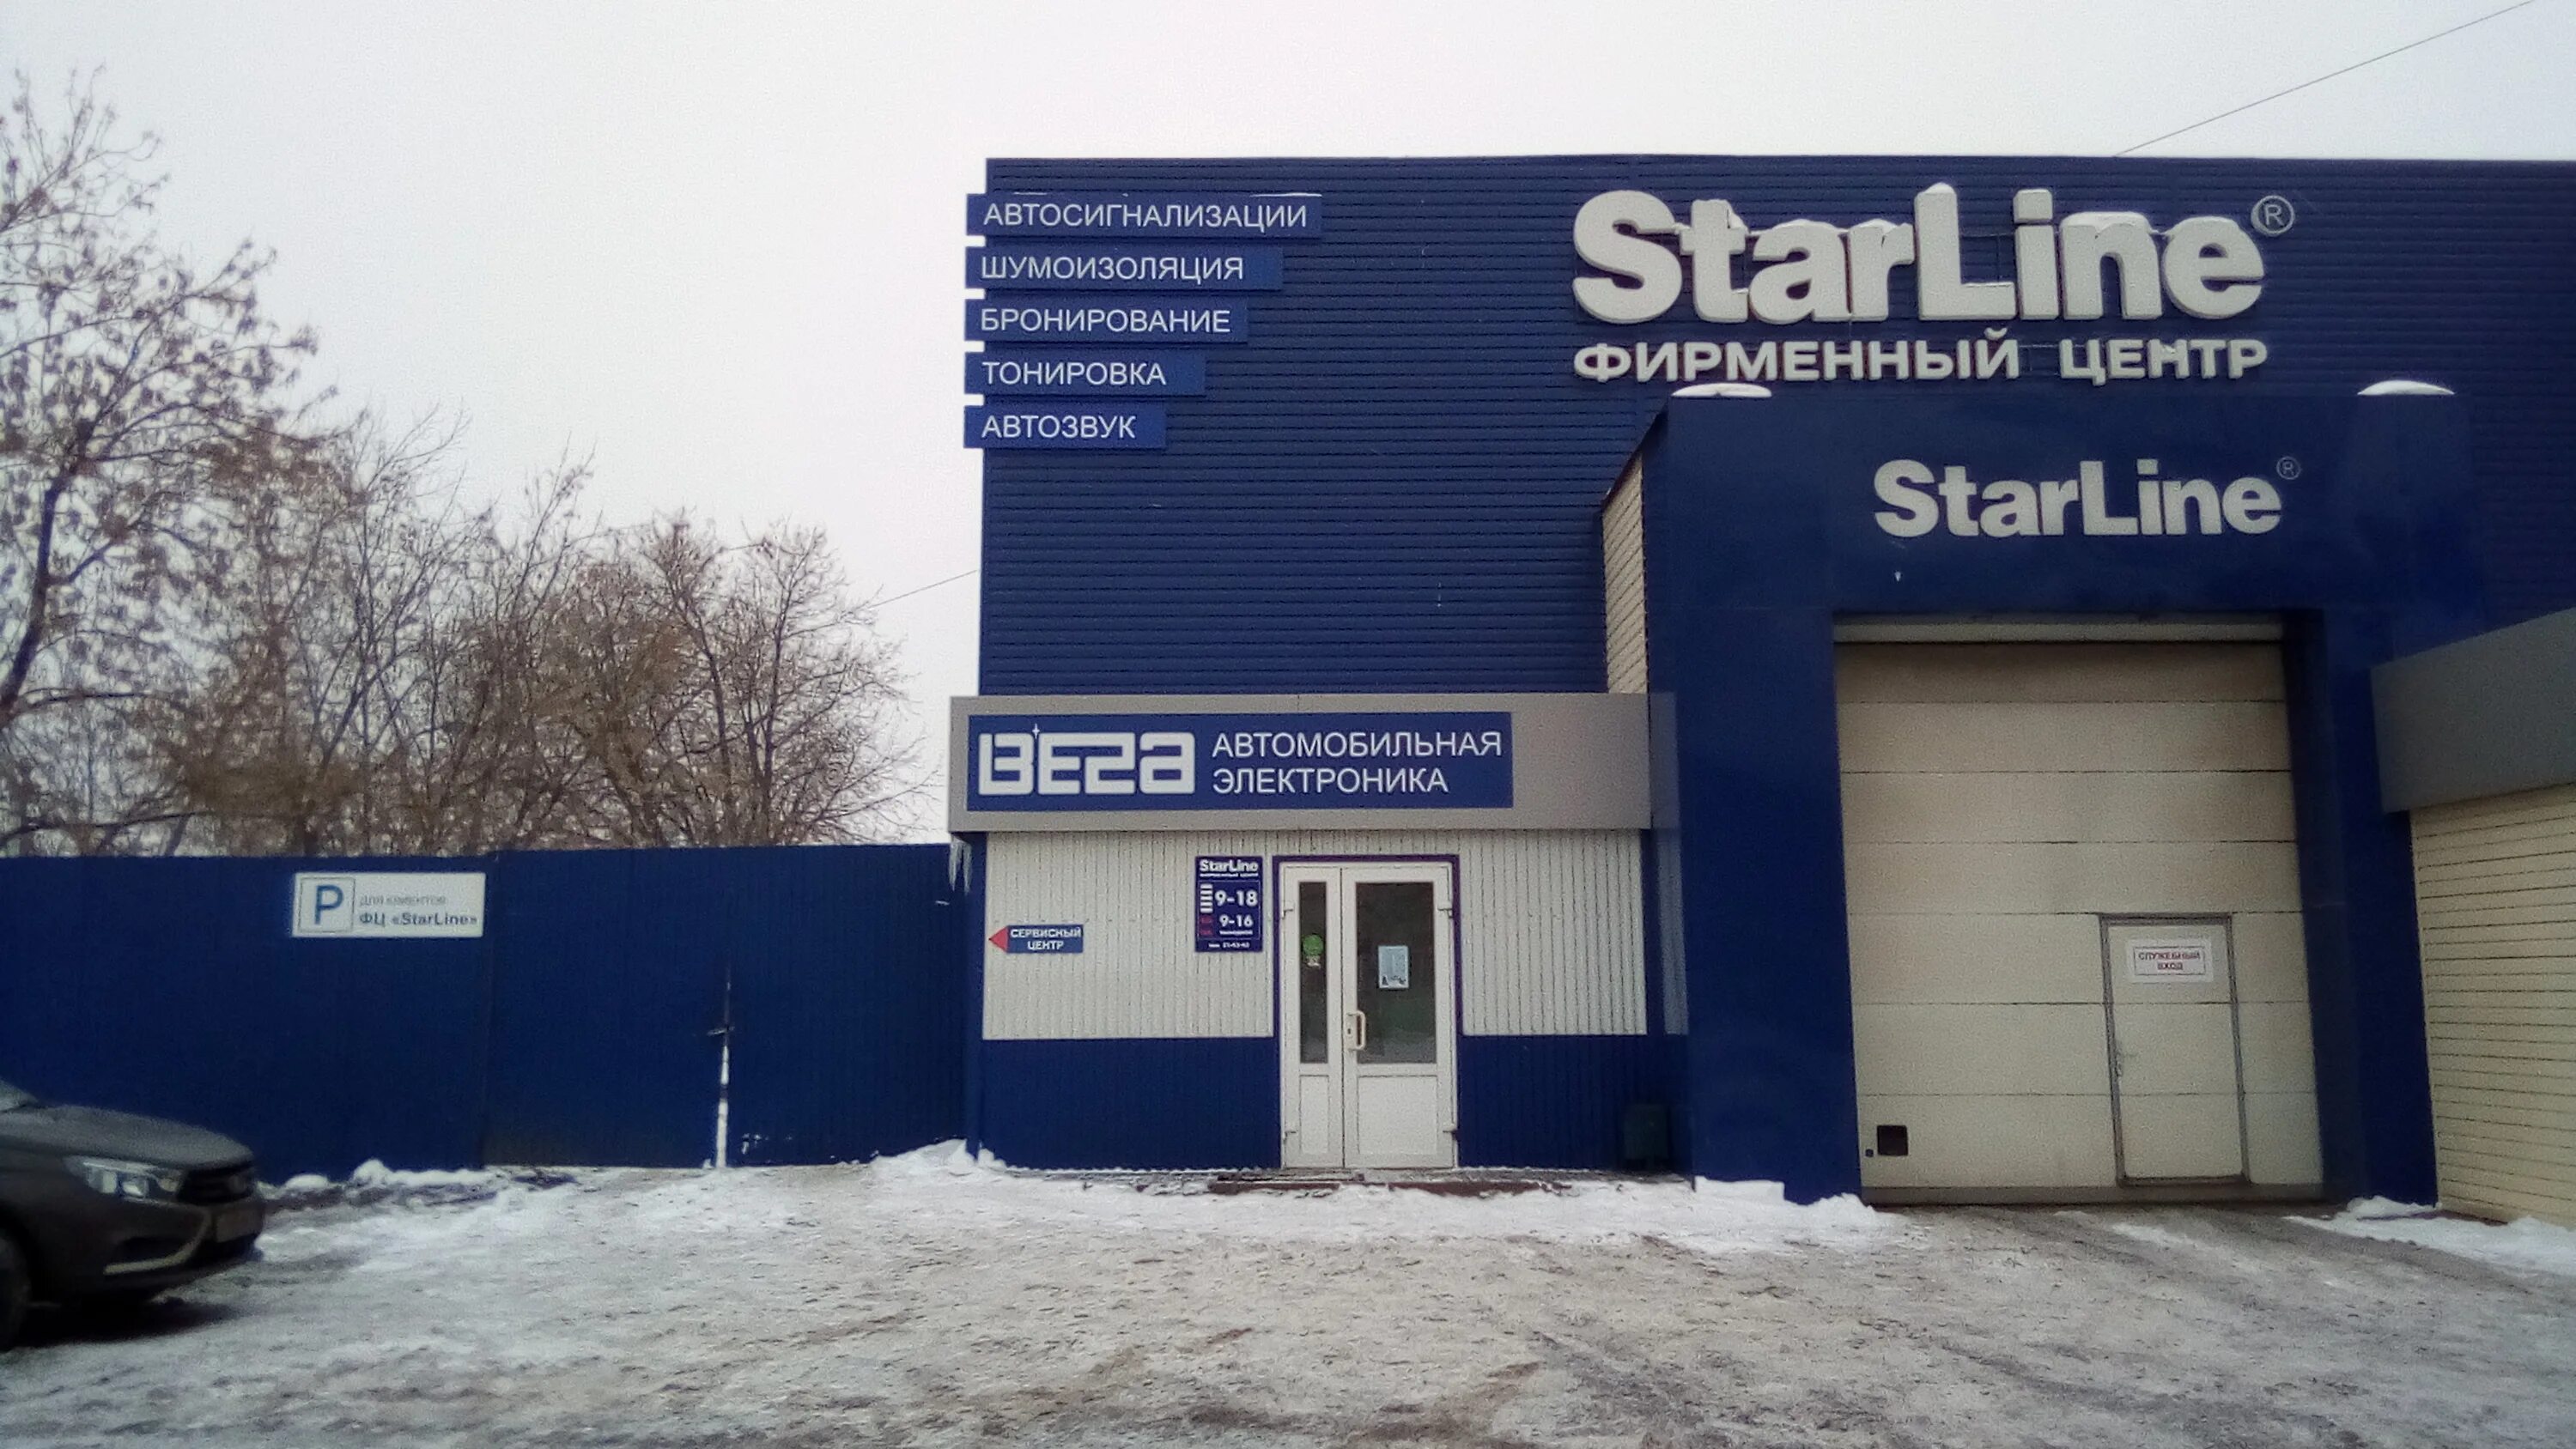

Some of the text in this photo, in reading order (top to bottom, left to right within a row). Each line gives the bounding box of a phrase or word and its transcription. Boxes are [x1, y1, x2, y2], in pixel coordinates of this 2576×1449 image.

[983, 203, 1307, 233] АВТОСИГНАЛИЗАЦИИ
[1572, 183, 2265, 324] StarLine
[981, 256, 1243, 285] ШУМОИЗОЛЯЦИЯ
[981, 308, 1230, 332] БРОНИРОВАНИЕ
[1573, 327, 2268, 386] ФИРМЕННЫЙ ЦЕНТР
[982, 361, 1166, 385] ТОНИРОВКА
[981, 415, 1136, 440] АВТОЗВУК
[1874, 458, 2282, 538] StarLine
[1212, 731, 1503, 758] АВТОМОБИЛЬНАЯ
[1212, 767, 1449, 794] ЭЛЕКТРОНИКА
[1200, 859, 1259, 873] StarLine
[1214, 889, 1259, 907] 9-18
[1010, 927, 1081, 938] СЕРВИСНЫЙ
[1219, 913, 1254, 928] 9-16
[1027, 940, 1064, 950] ЦЕНТР
